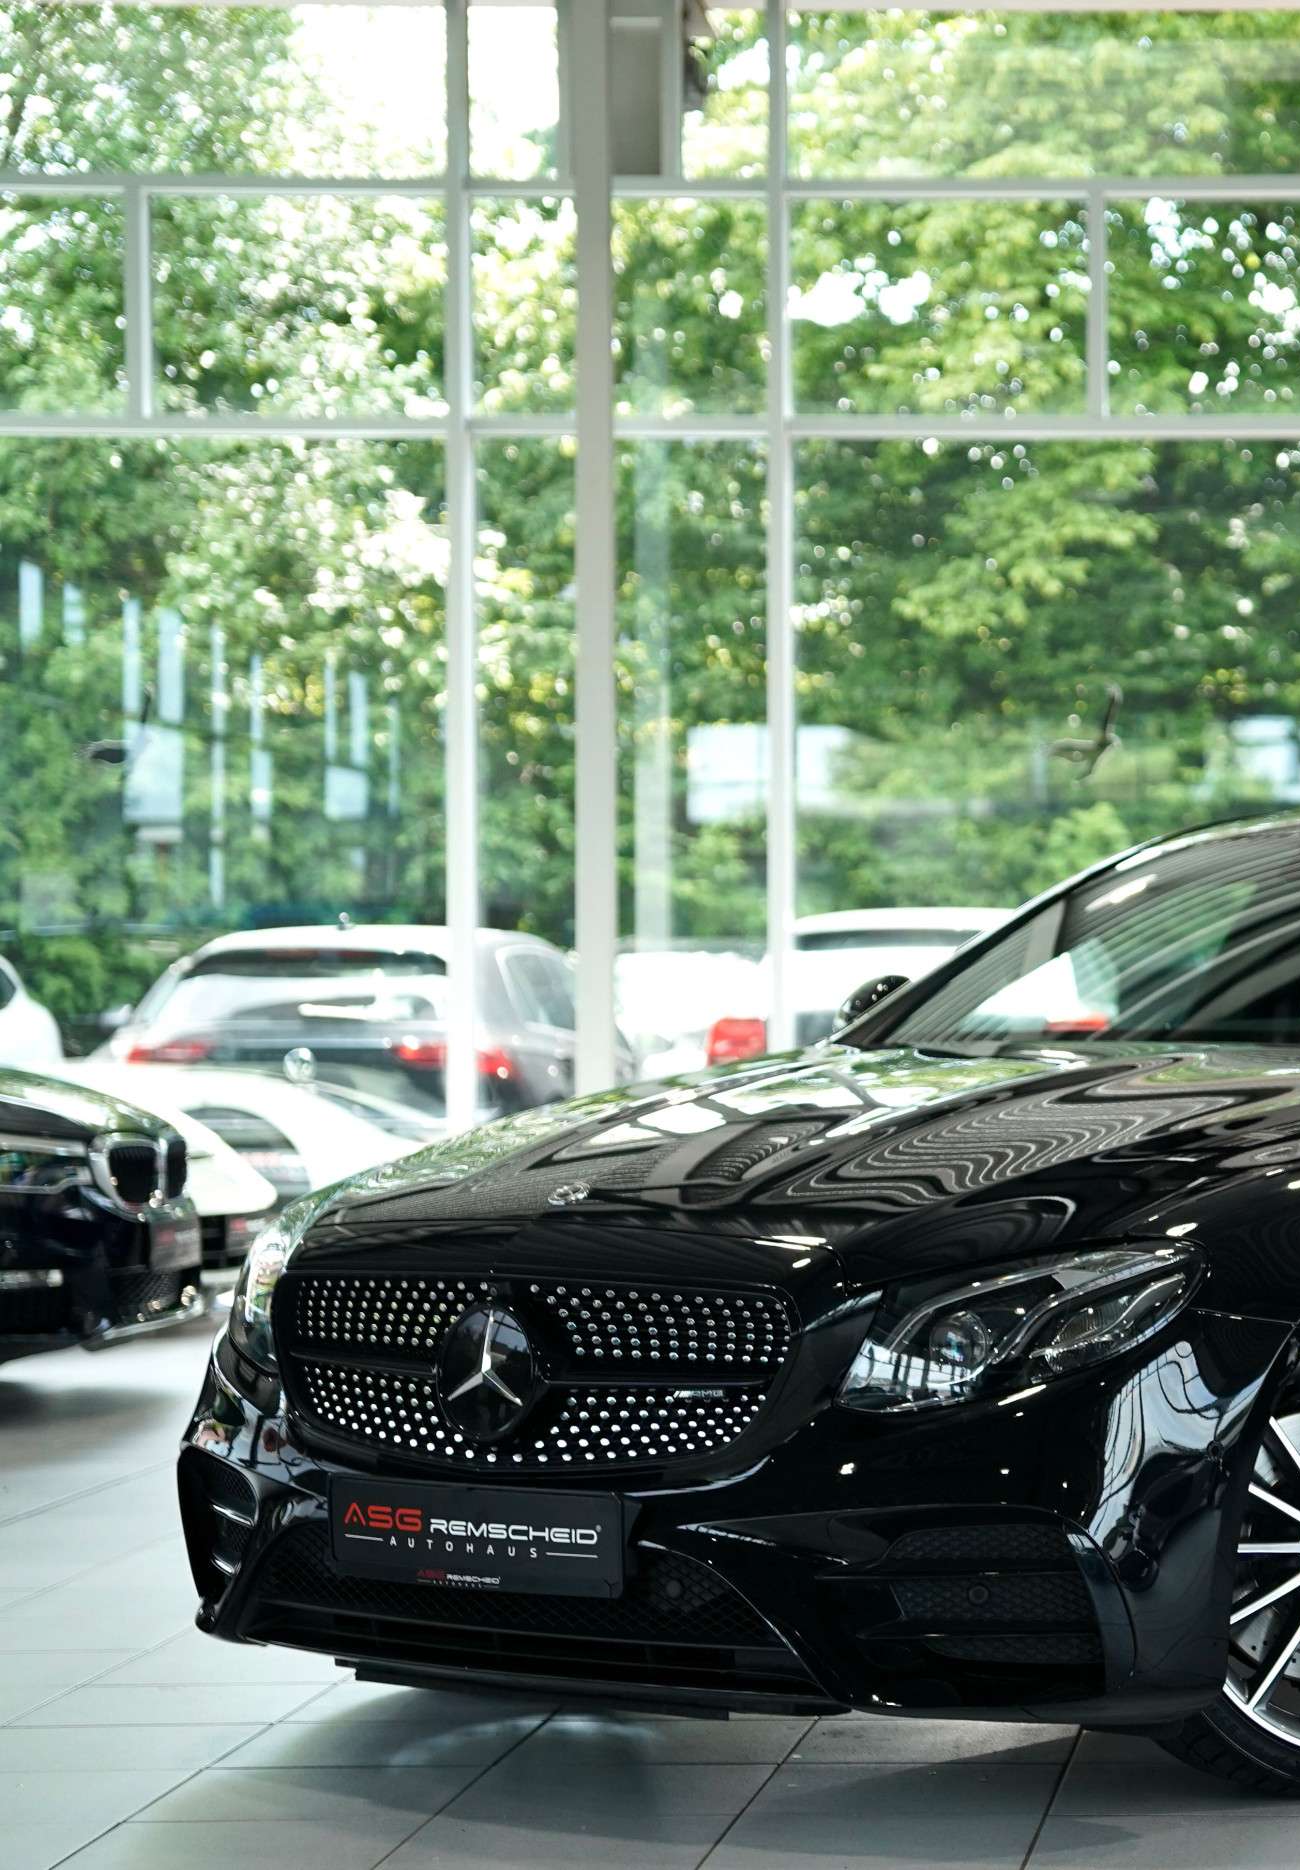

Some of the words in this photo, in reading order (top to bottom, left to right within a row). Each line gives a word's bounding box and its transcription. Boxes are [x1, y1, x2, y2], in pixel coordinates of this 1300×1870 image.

[344, 1502, 422, 1532] ASG
[430, 1518, 598, 1545] REMSCHEID
[389, 1535, 538, 1558] AUTOHAUS
